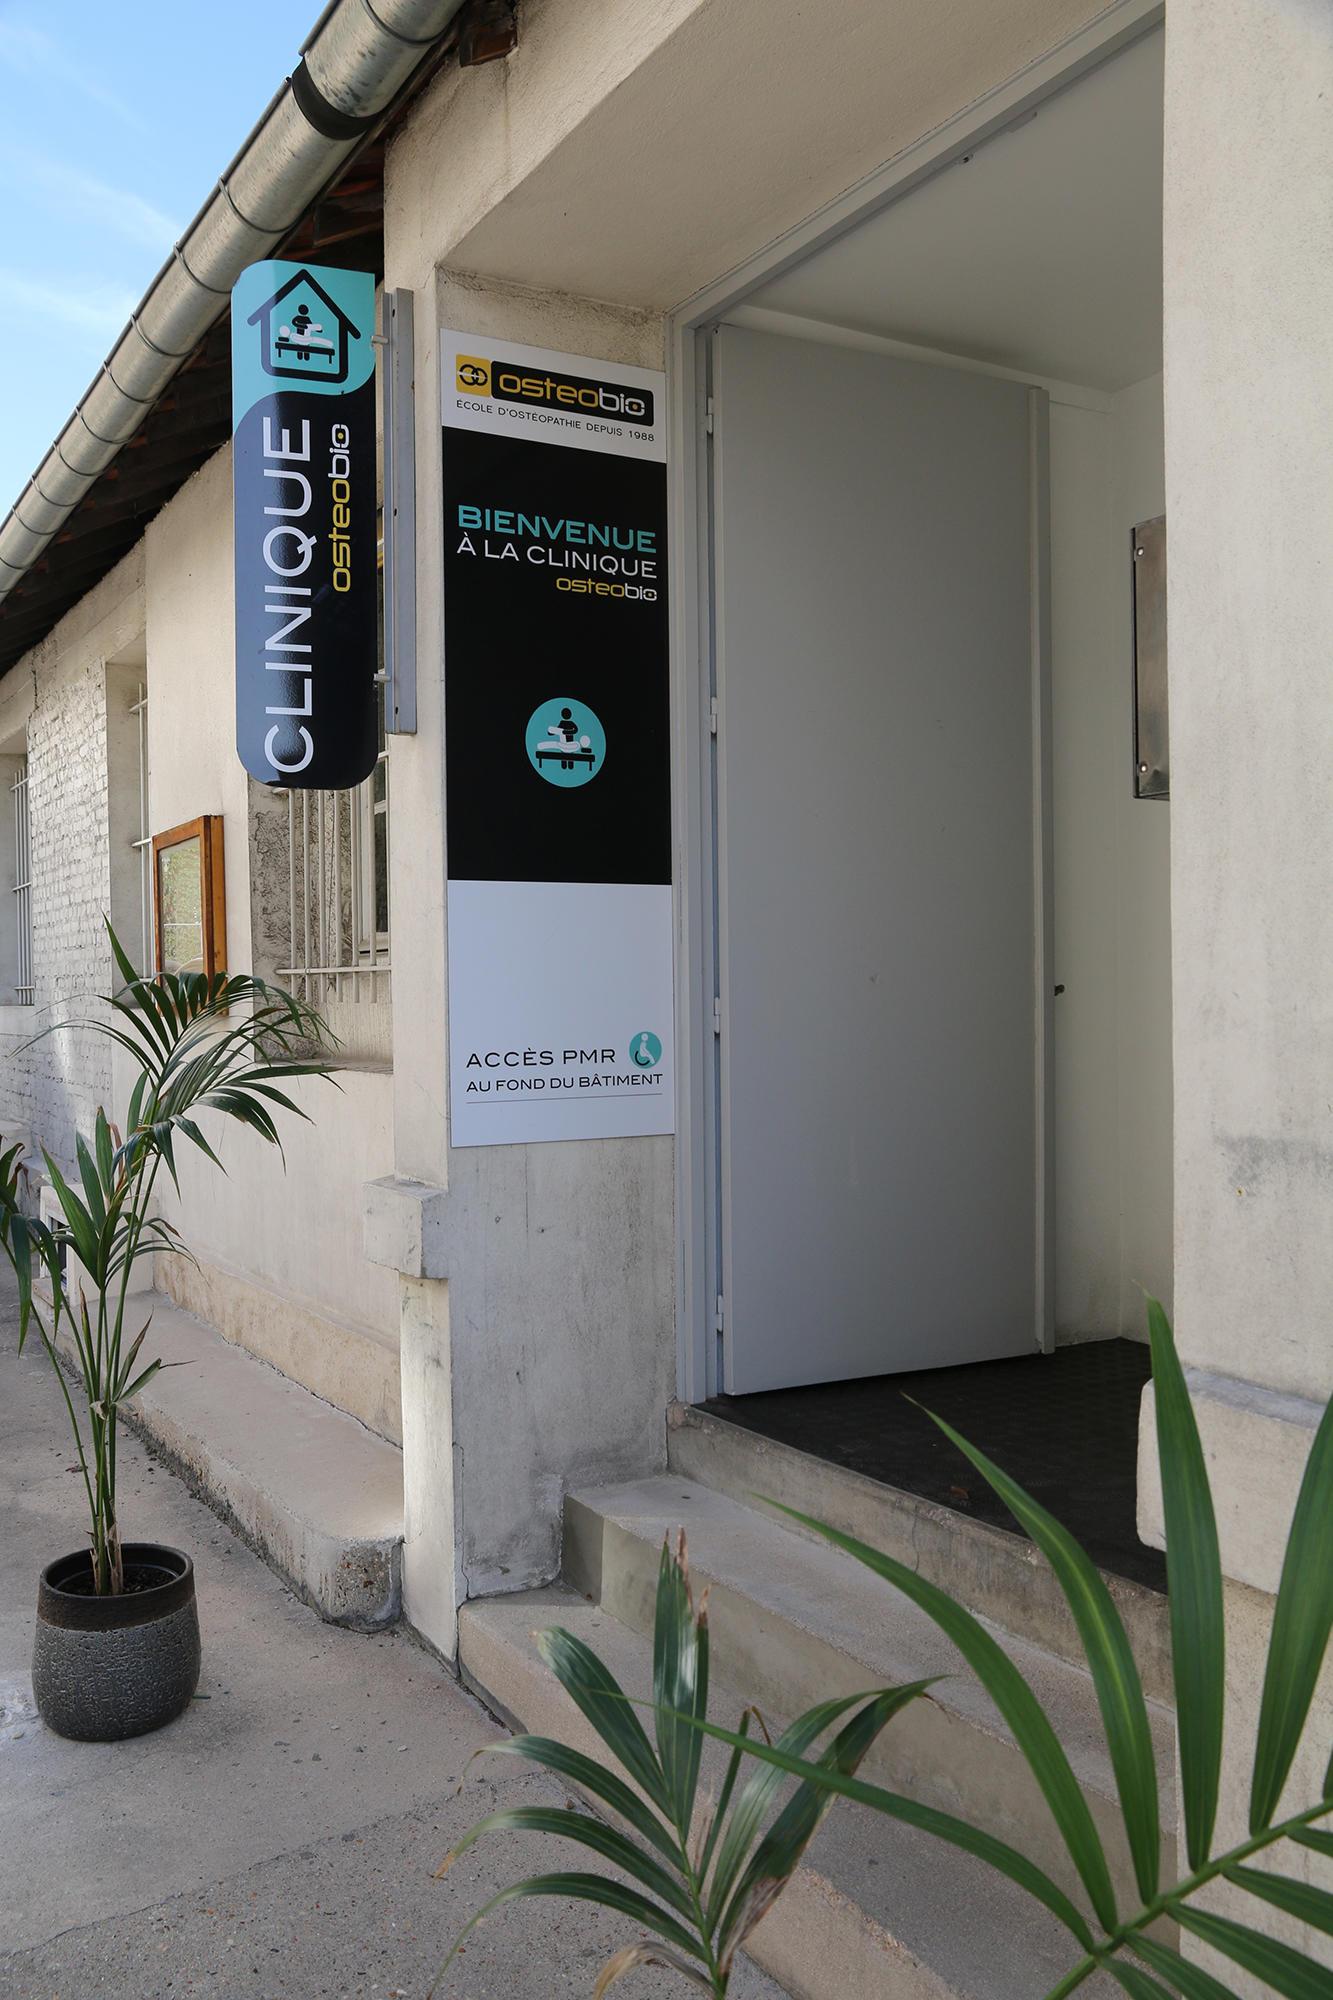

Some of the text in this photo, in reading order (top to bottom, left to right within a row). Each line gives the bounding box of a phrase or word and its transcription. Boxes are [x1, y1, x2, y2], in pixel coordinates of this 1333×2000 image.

[499, 373, 646, 417] osteobio
[456, 398, 655, 442] ÉCOLE D'OSTÉOPATHIE DEPUIS 1988
[328, 423, 351, 593] osteobio
[458, 504, 657, 554] BIENVENUE
[456, 531, 657, 579] À LA CLINIQUE
[262, 416, 317, 774] CLINIQUE
[556, 577, 658, 602] osteobio
[466, 1047, 616, 1069] ACCÈS PMR
[466, 1073, 663, 1093] AU FOND DU BÂTIMENT
